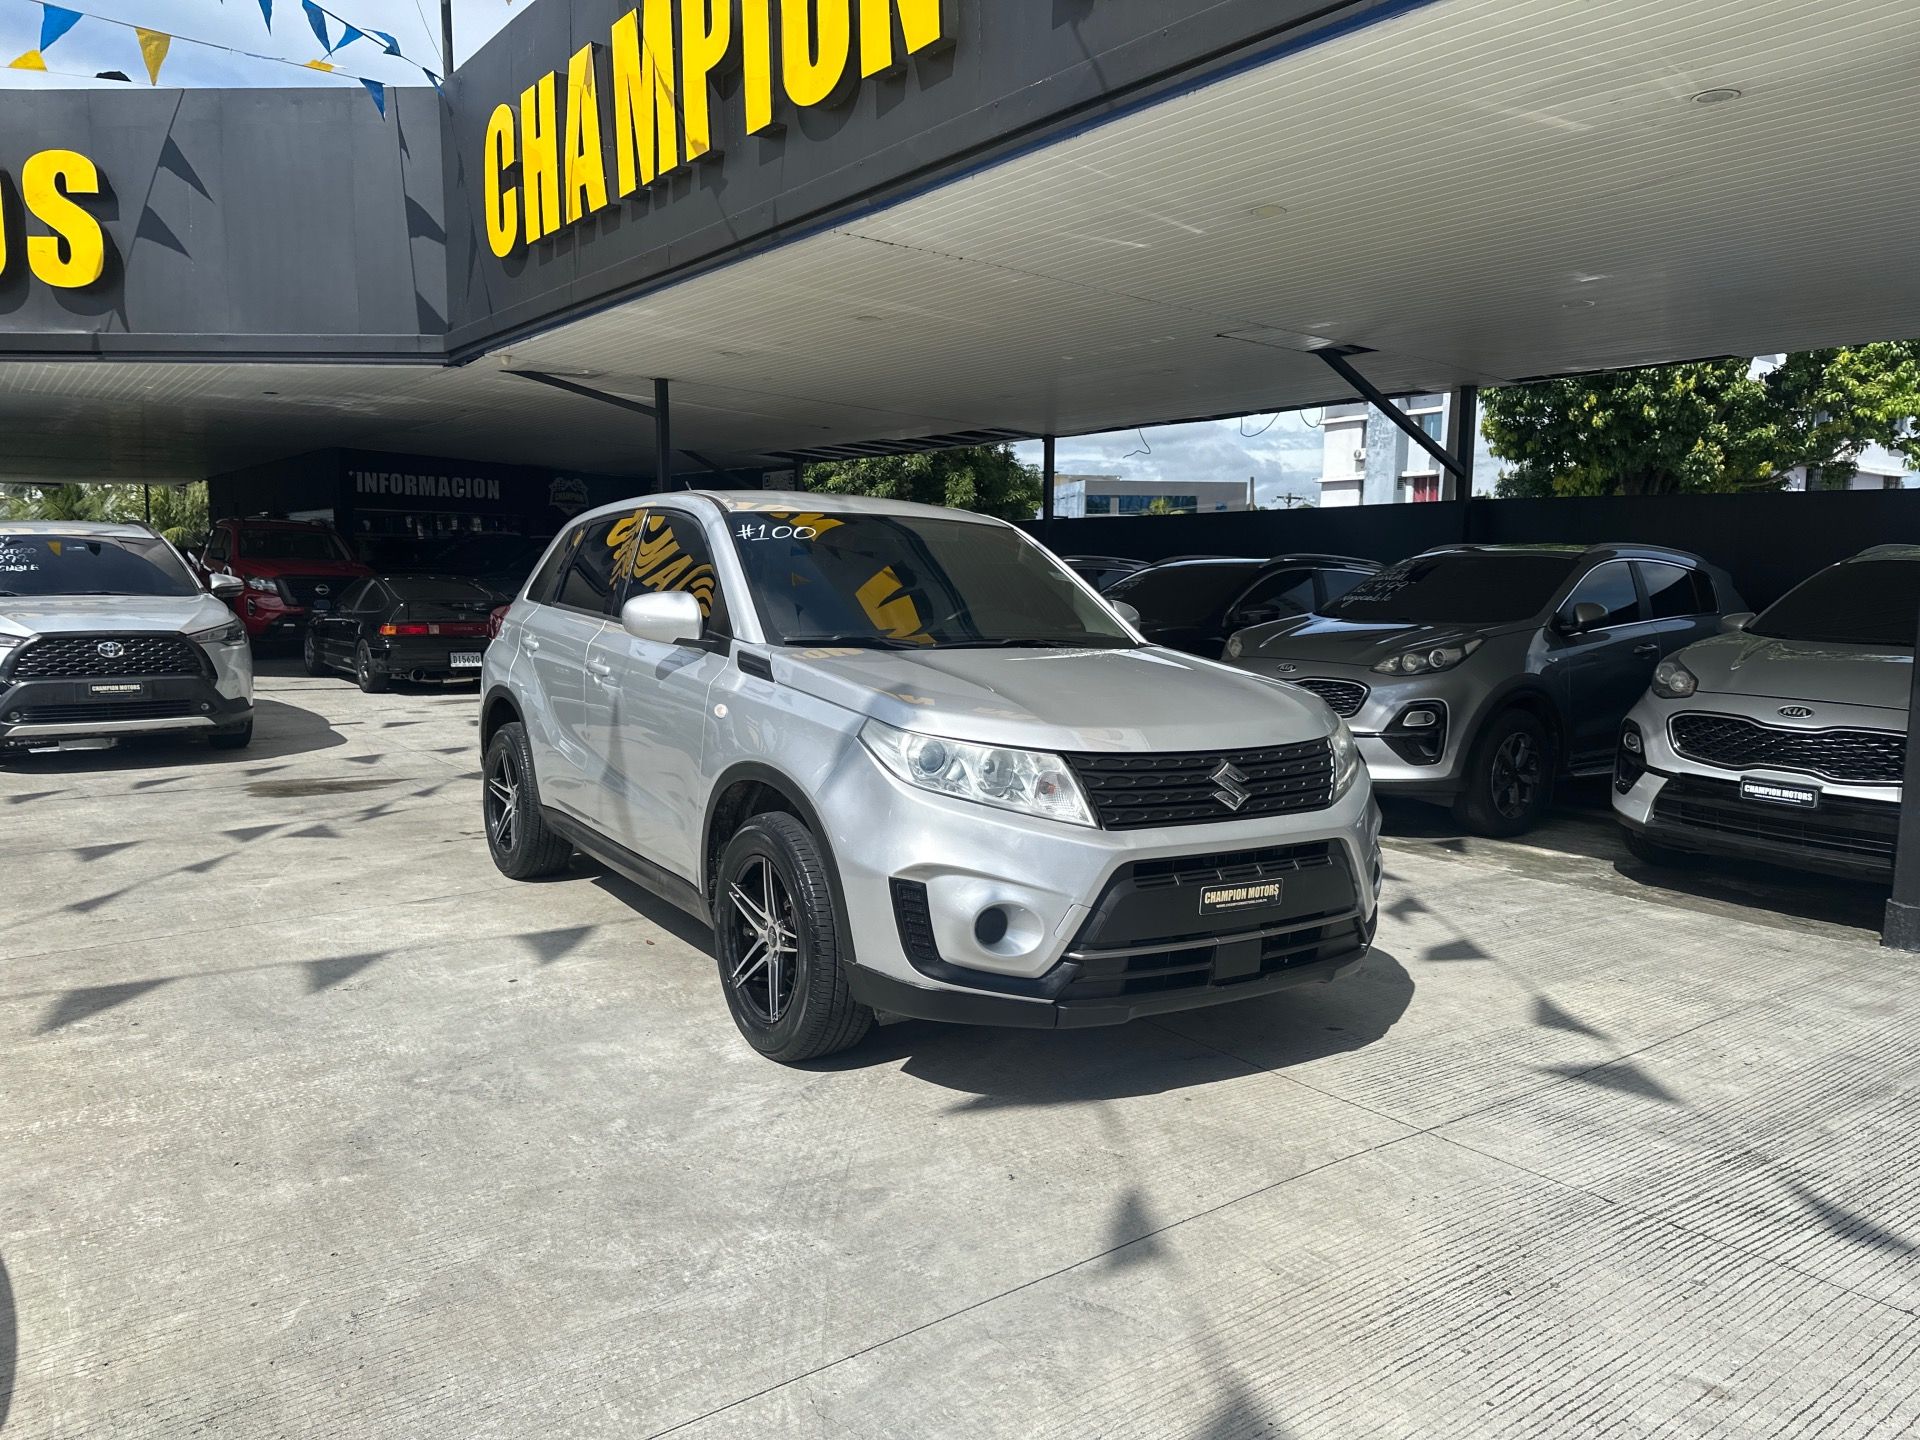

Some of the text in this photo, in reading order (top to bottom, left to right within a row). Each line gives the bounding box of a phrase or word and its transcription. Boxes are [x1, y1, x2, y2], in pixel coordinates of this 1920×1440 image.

[0, 149, 104, 288] S
[356, 471, 500, 500] INFORMACION
[736, 524, 817, 541] #100
[1783, 707, 1807, 716] KIA
[1744, 785, 1781, 796] CHAMPION
[1782, 789, 1813, 801] MOTORS
[1205, 884, 1280, 903] CHAMPION MOTORS
